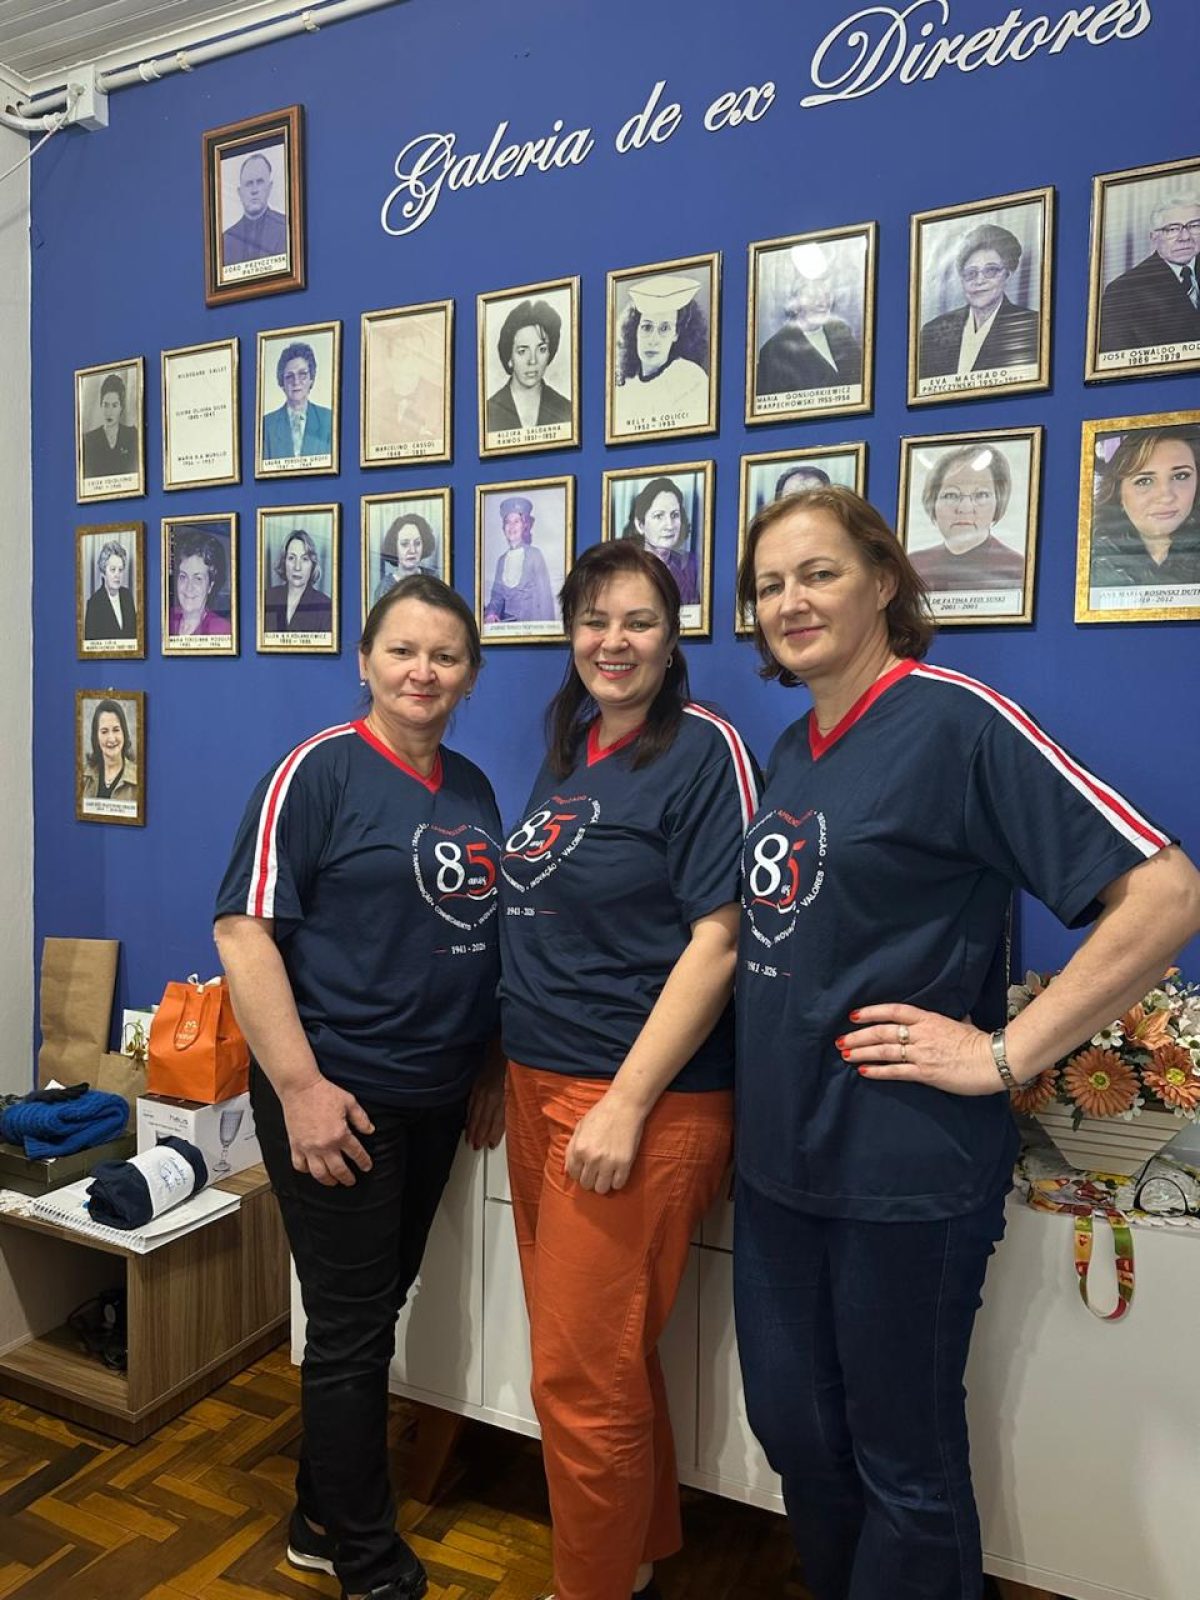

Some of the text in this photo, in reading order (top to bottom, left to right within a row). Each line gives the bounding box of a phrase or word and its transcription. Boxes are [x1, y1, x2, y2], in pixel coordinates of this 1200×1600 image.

[381, 0, 1153, 237] Galeria de ex Diretores
[955, 370, 1007, 382] MACHADO
[505, 810, 579, 857] 85
[434, 841, 497, 896] 85
[800, 870, 825, 907] VALORES
